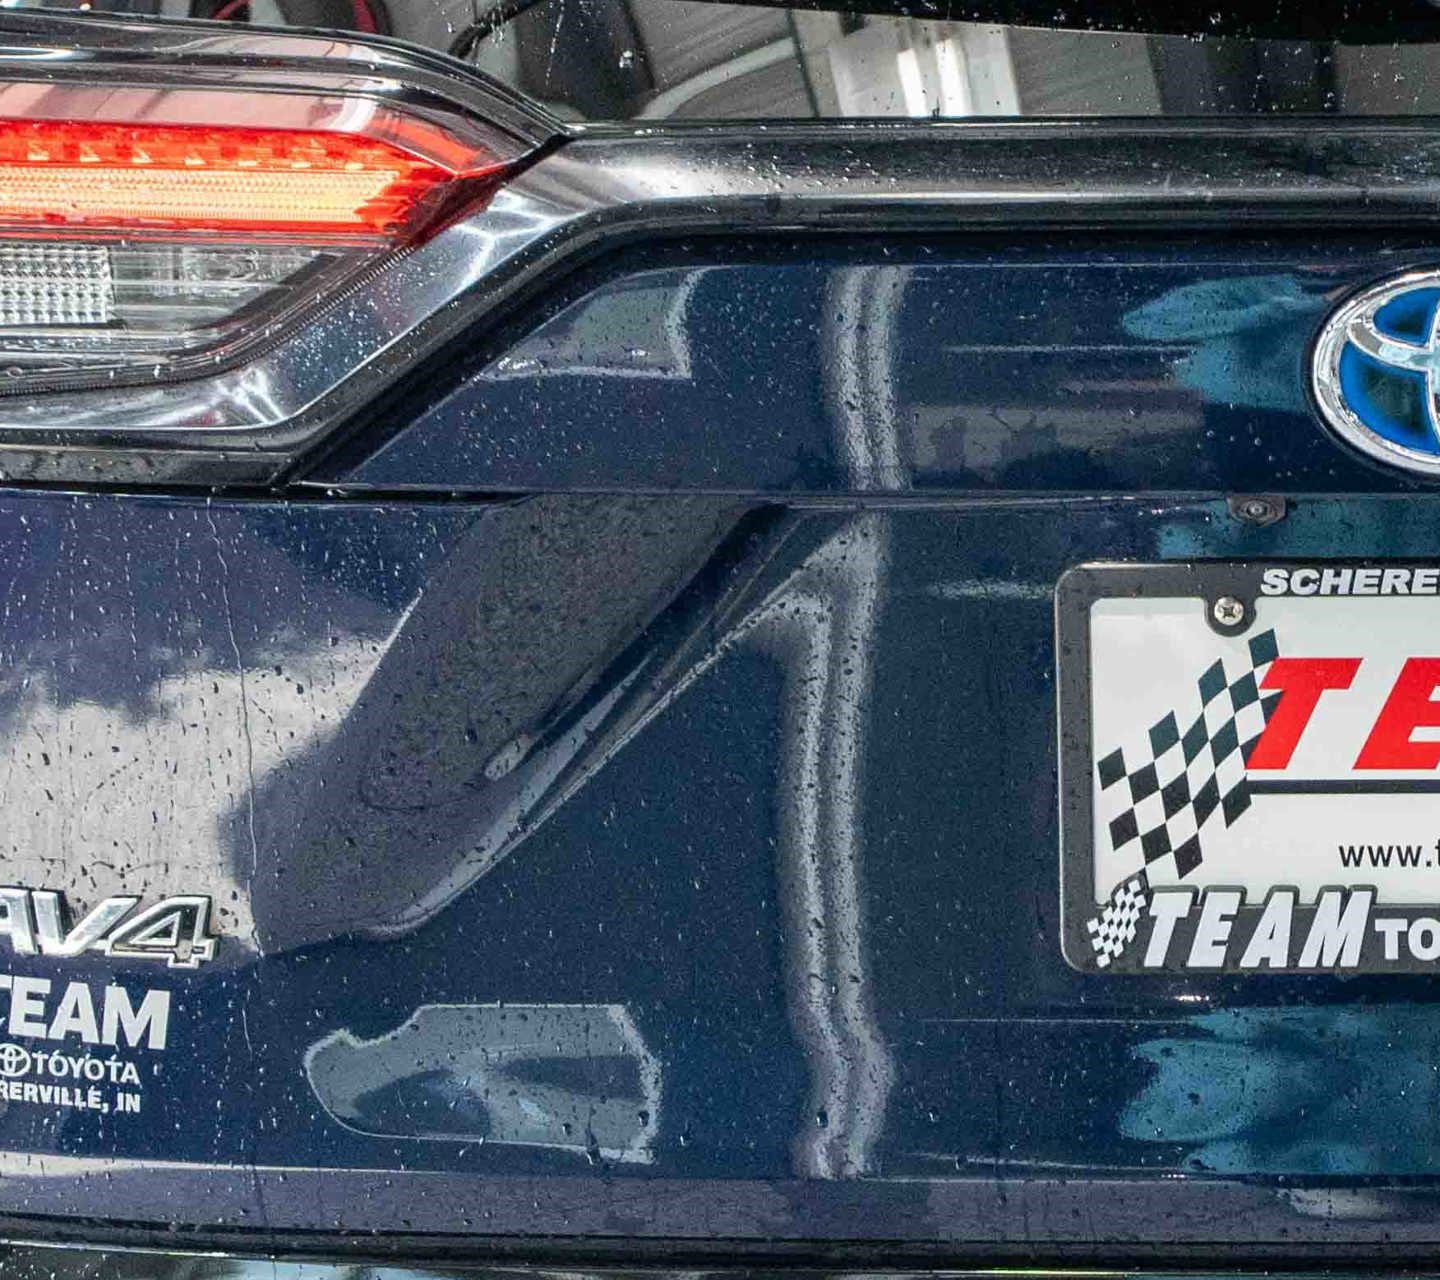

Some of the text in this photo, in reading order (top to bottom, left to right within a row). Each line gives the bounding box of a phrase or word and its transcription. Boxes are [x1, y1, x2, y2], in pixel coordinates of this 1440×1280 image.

[1142, 891, 1374, 969] TEAM
[31, 1051, 141, 1084] TOYOTA
[117, 1092, 141, 1113] IN
